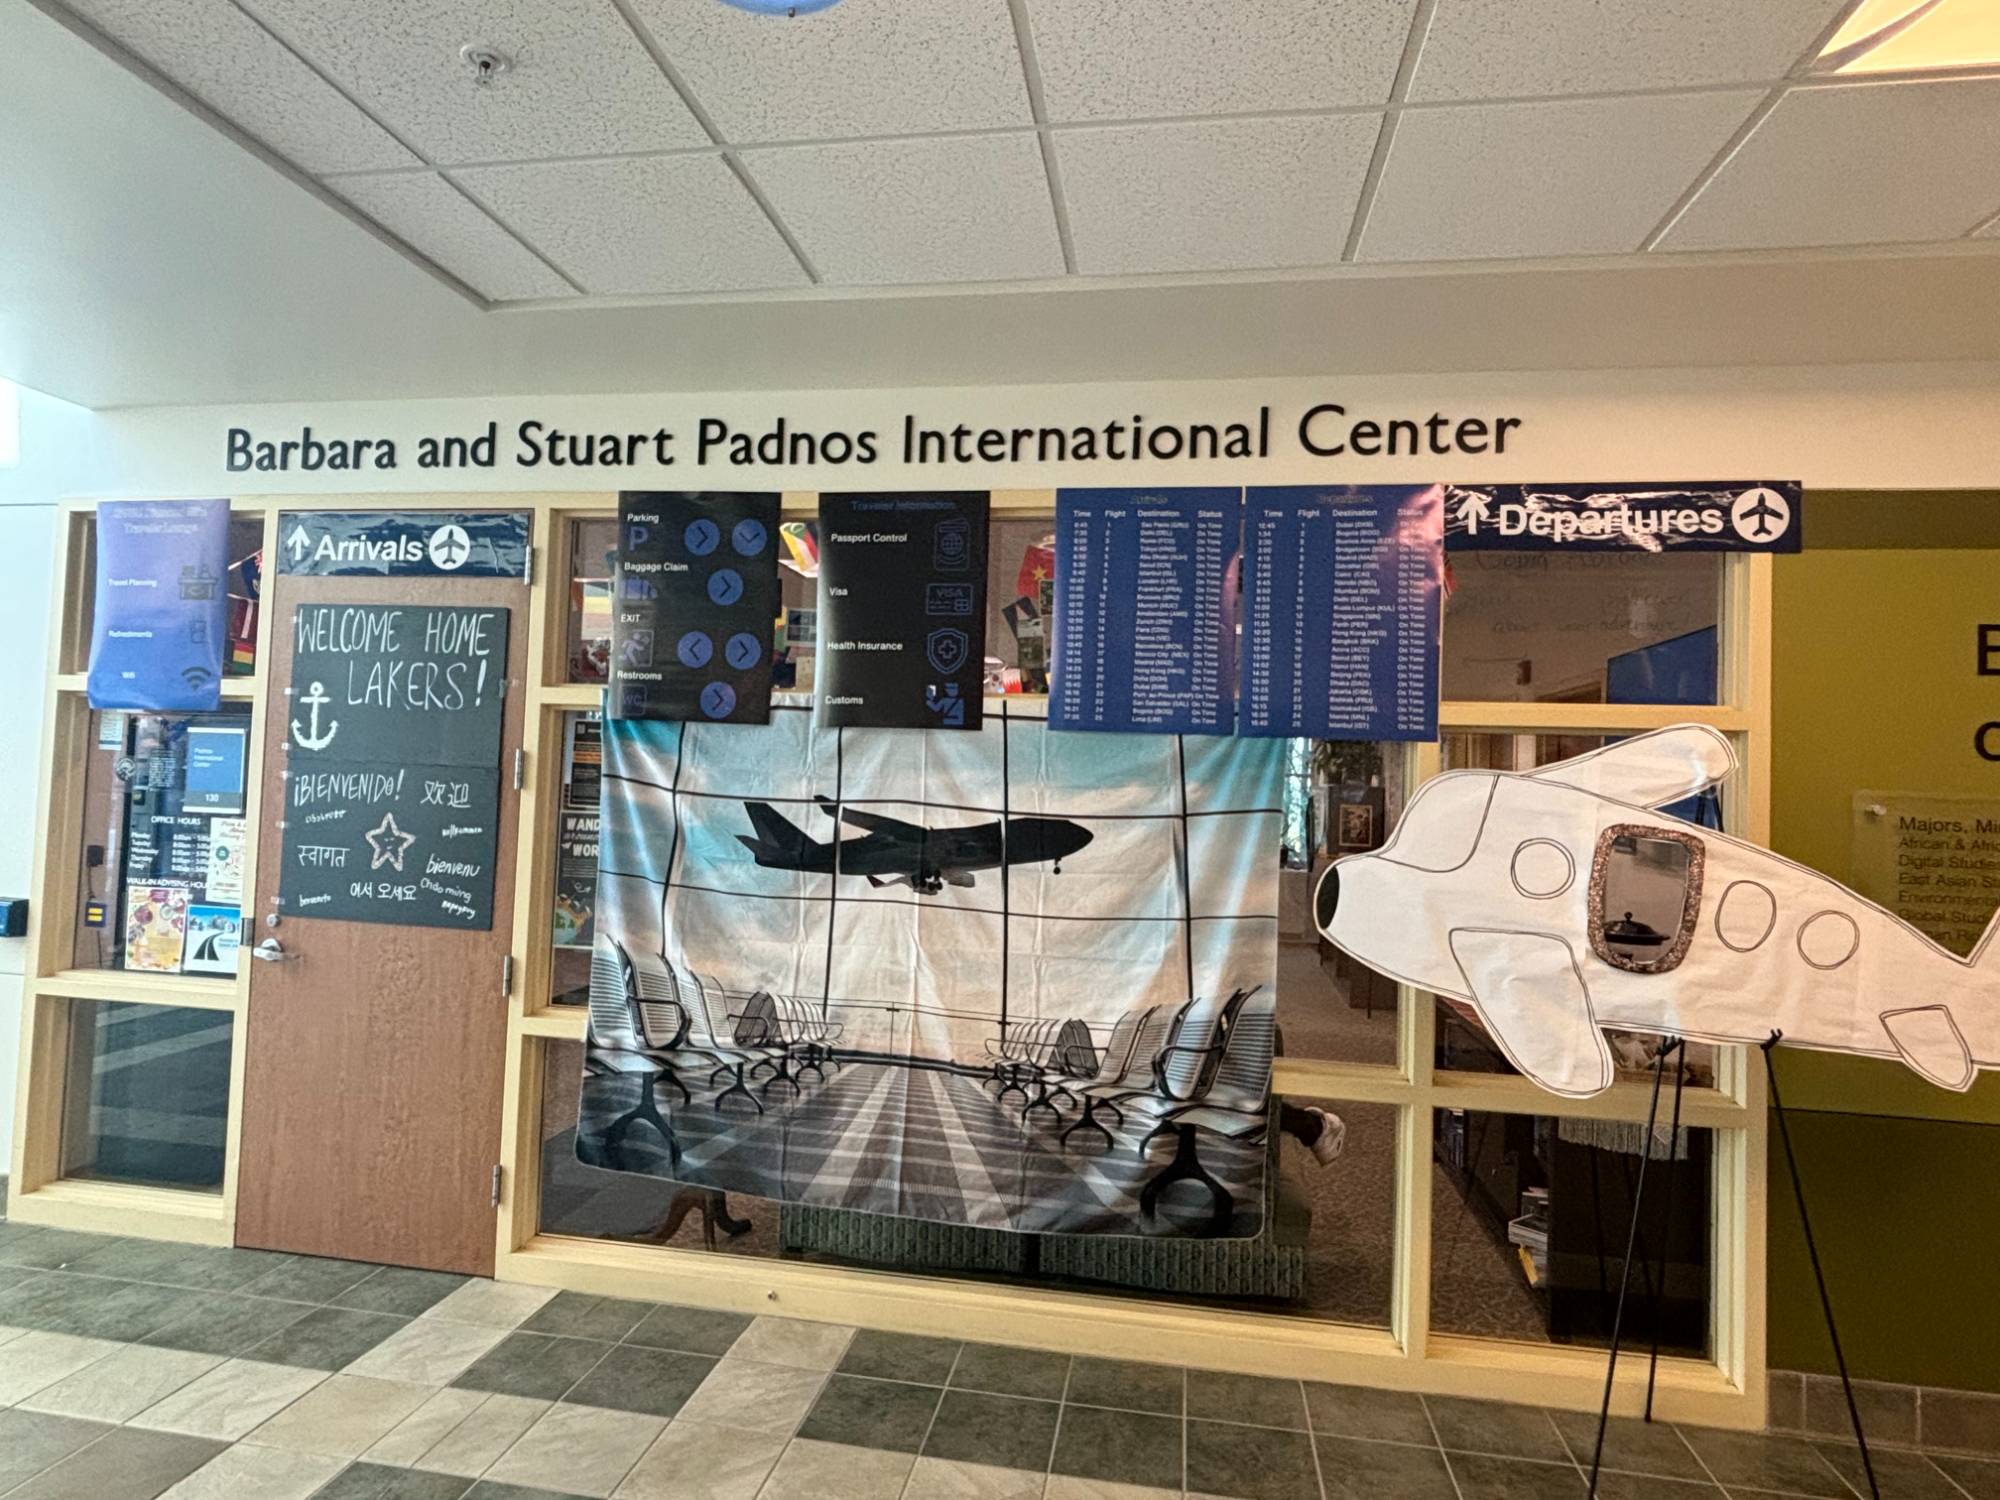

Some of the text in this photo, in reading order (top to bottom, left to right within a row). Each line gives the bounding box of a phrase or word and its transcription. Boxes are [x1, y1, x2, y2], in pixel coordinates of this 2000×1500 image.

[226, 403, 1522, 473] Barbara and Stuart Padnos International Center
[627, 513, 660, 524] Parking
[1073, 509, 1223, 519] Time Flight Destination Status
[1263, 508, 1424, 520] Time Flight Destination Status
[1499, 503, 1724, 543] Departures
[831, 533, 908, 543] Passport Control
[314, 534, 423, 561] Arrivals
[624, 562, 689, 572] Baggage Claim
[829, 586, 848, 597] Visa
[620, 614, 641, 623] EXIT
[298, 608, 495, 656] WELCOME HOME
[827, 641, 903, 651] Health Insurance
[617, 671, 662, 681] Restrooms
[347, 659, 488, 711] LAKERS!
[825, 695, 864, 705] Customs
[205, 793, 219, 802] 130
[420, 780, 472, 808] 欢迎
[150, 815, 201, 825] OFFICE HOURS
[1954, 838, 1965, 850] &
[297, 845, 350, 868] स्वागत
[1899, 854, 1944, 870] Digital
[425, 853, 481, 878] bienvenu
[1899, 872, 1930, 885] East
[1936, 874, 1977, 888] Asian
[350, 882, 417, 901] 어서 오세요
